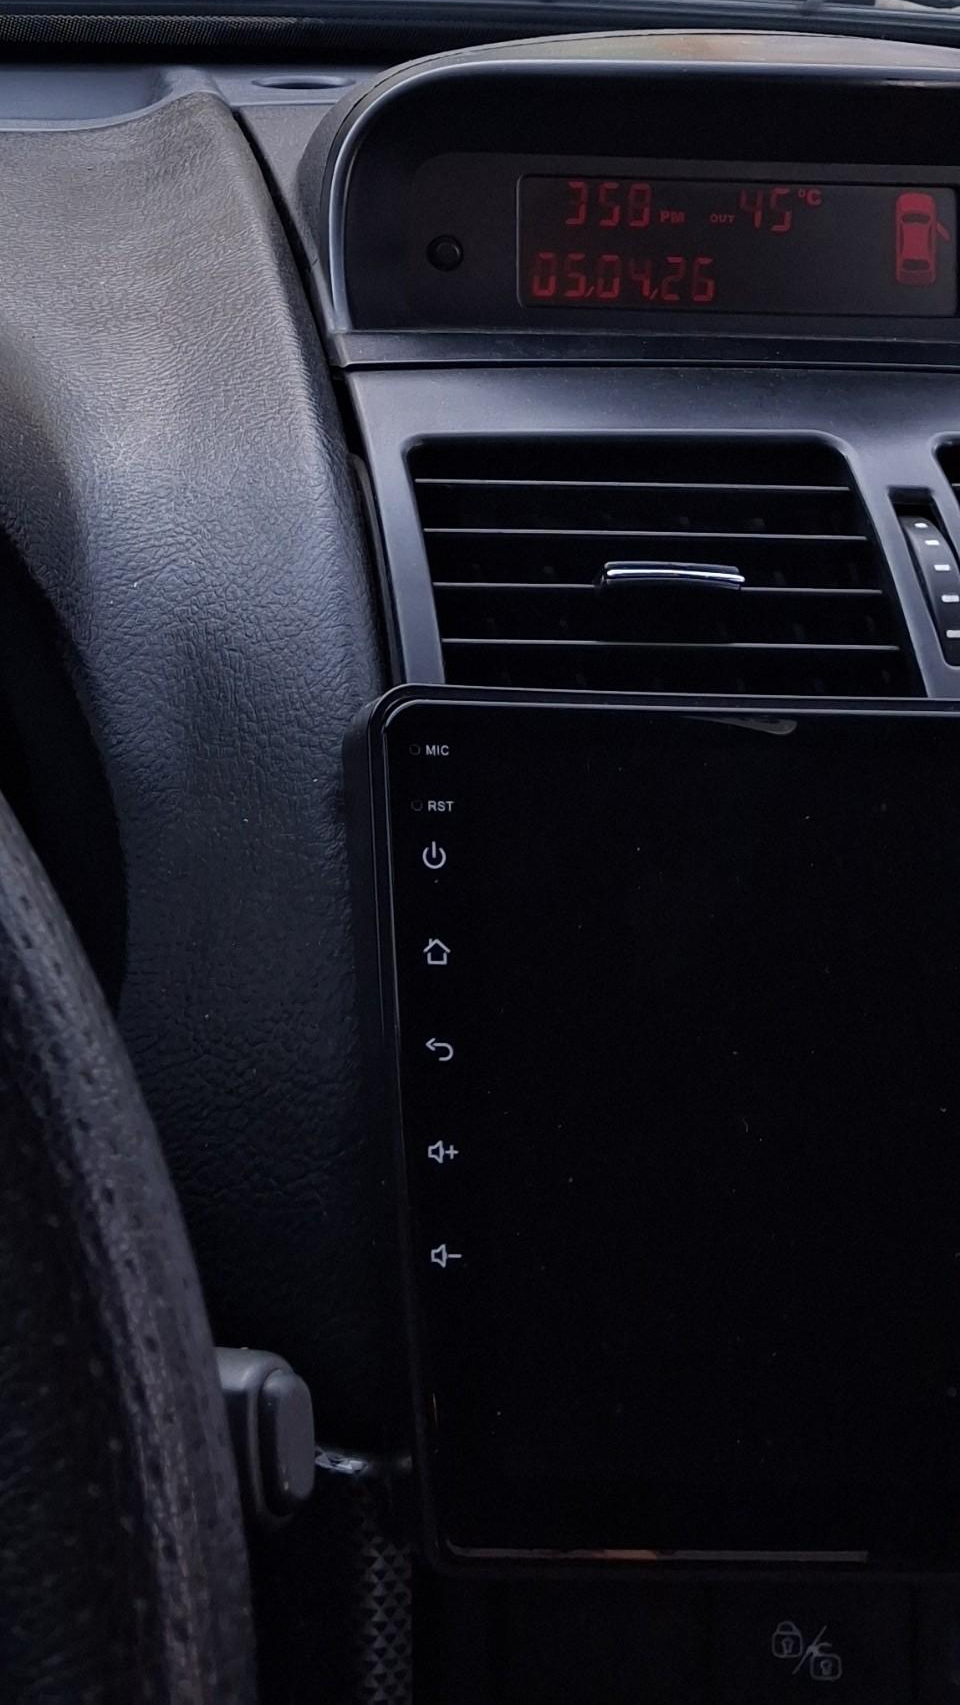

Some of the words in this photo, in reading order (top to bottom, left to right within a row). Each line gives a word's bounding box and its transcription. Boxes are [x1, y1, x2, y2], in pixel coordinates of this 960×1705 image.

[660, 210, 686, 224] PM
[709, 213, 736, 224] OUT
[740, 187, 792, 232] 45
[425, 744, 450, 756] MIC
[427, 800, 455, 812] RST
